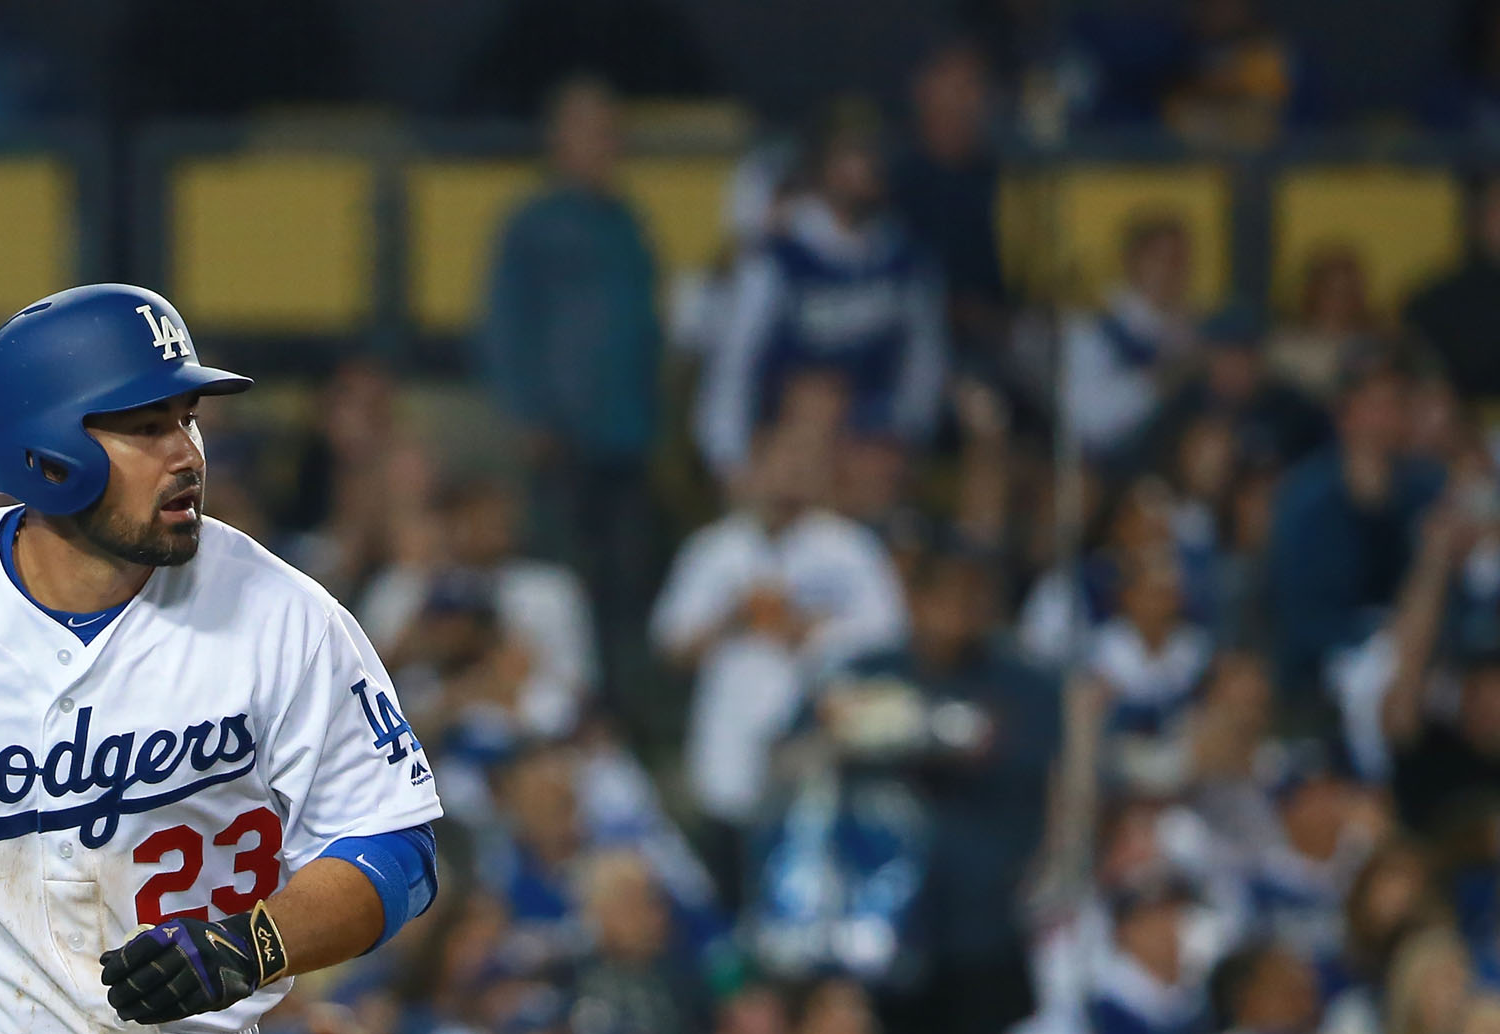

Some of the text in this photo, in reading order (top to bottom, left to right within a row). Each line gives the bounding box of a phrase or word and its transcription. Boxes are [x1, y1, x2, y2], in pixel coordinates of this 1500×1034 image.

[135, 304, 191, 361] LA
[350, 678, 422, 765] LA
[132, 806, 283, 926] 23
